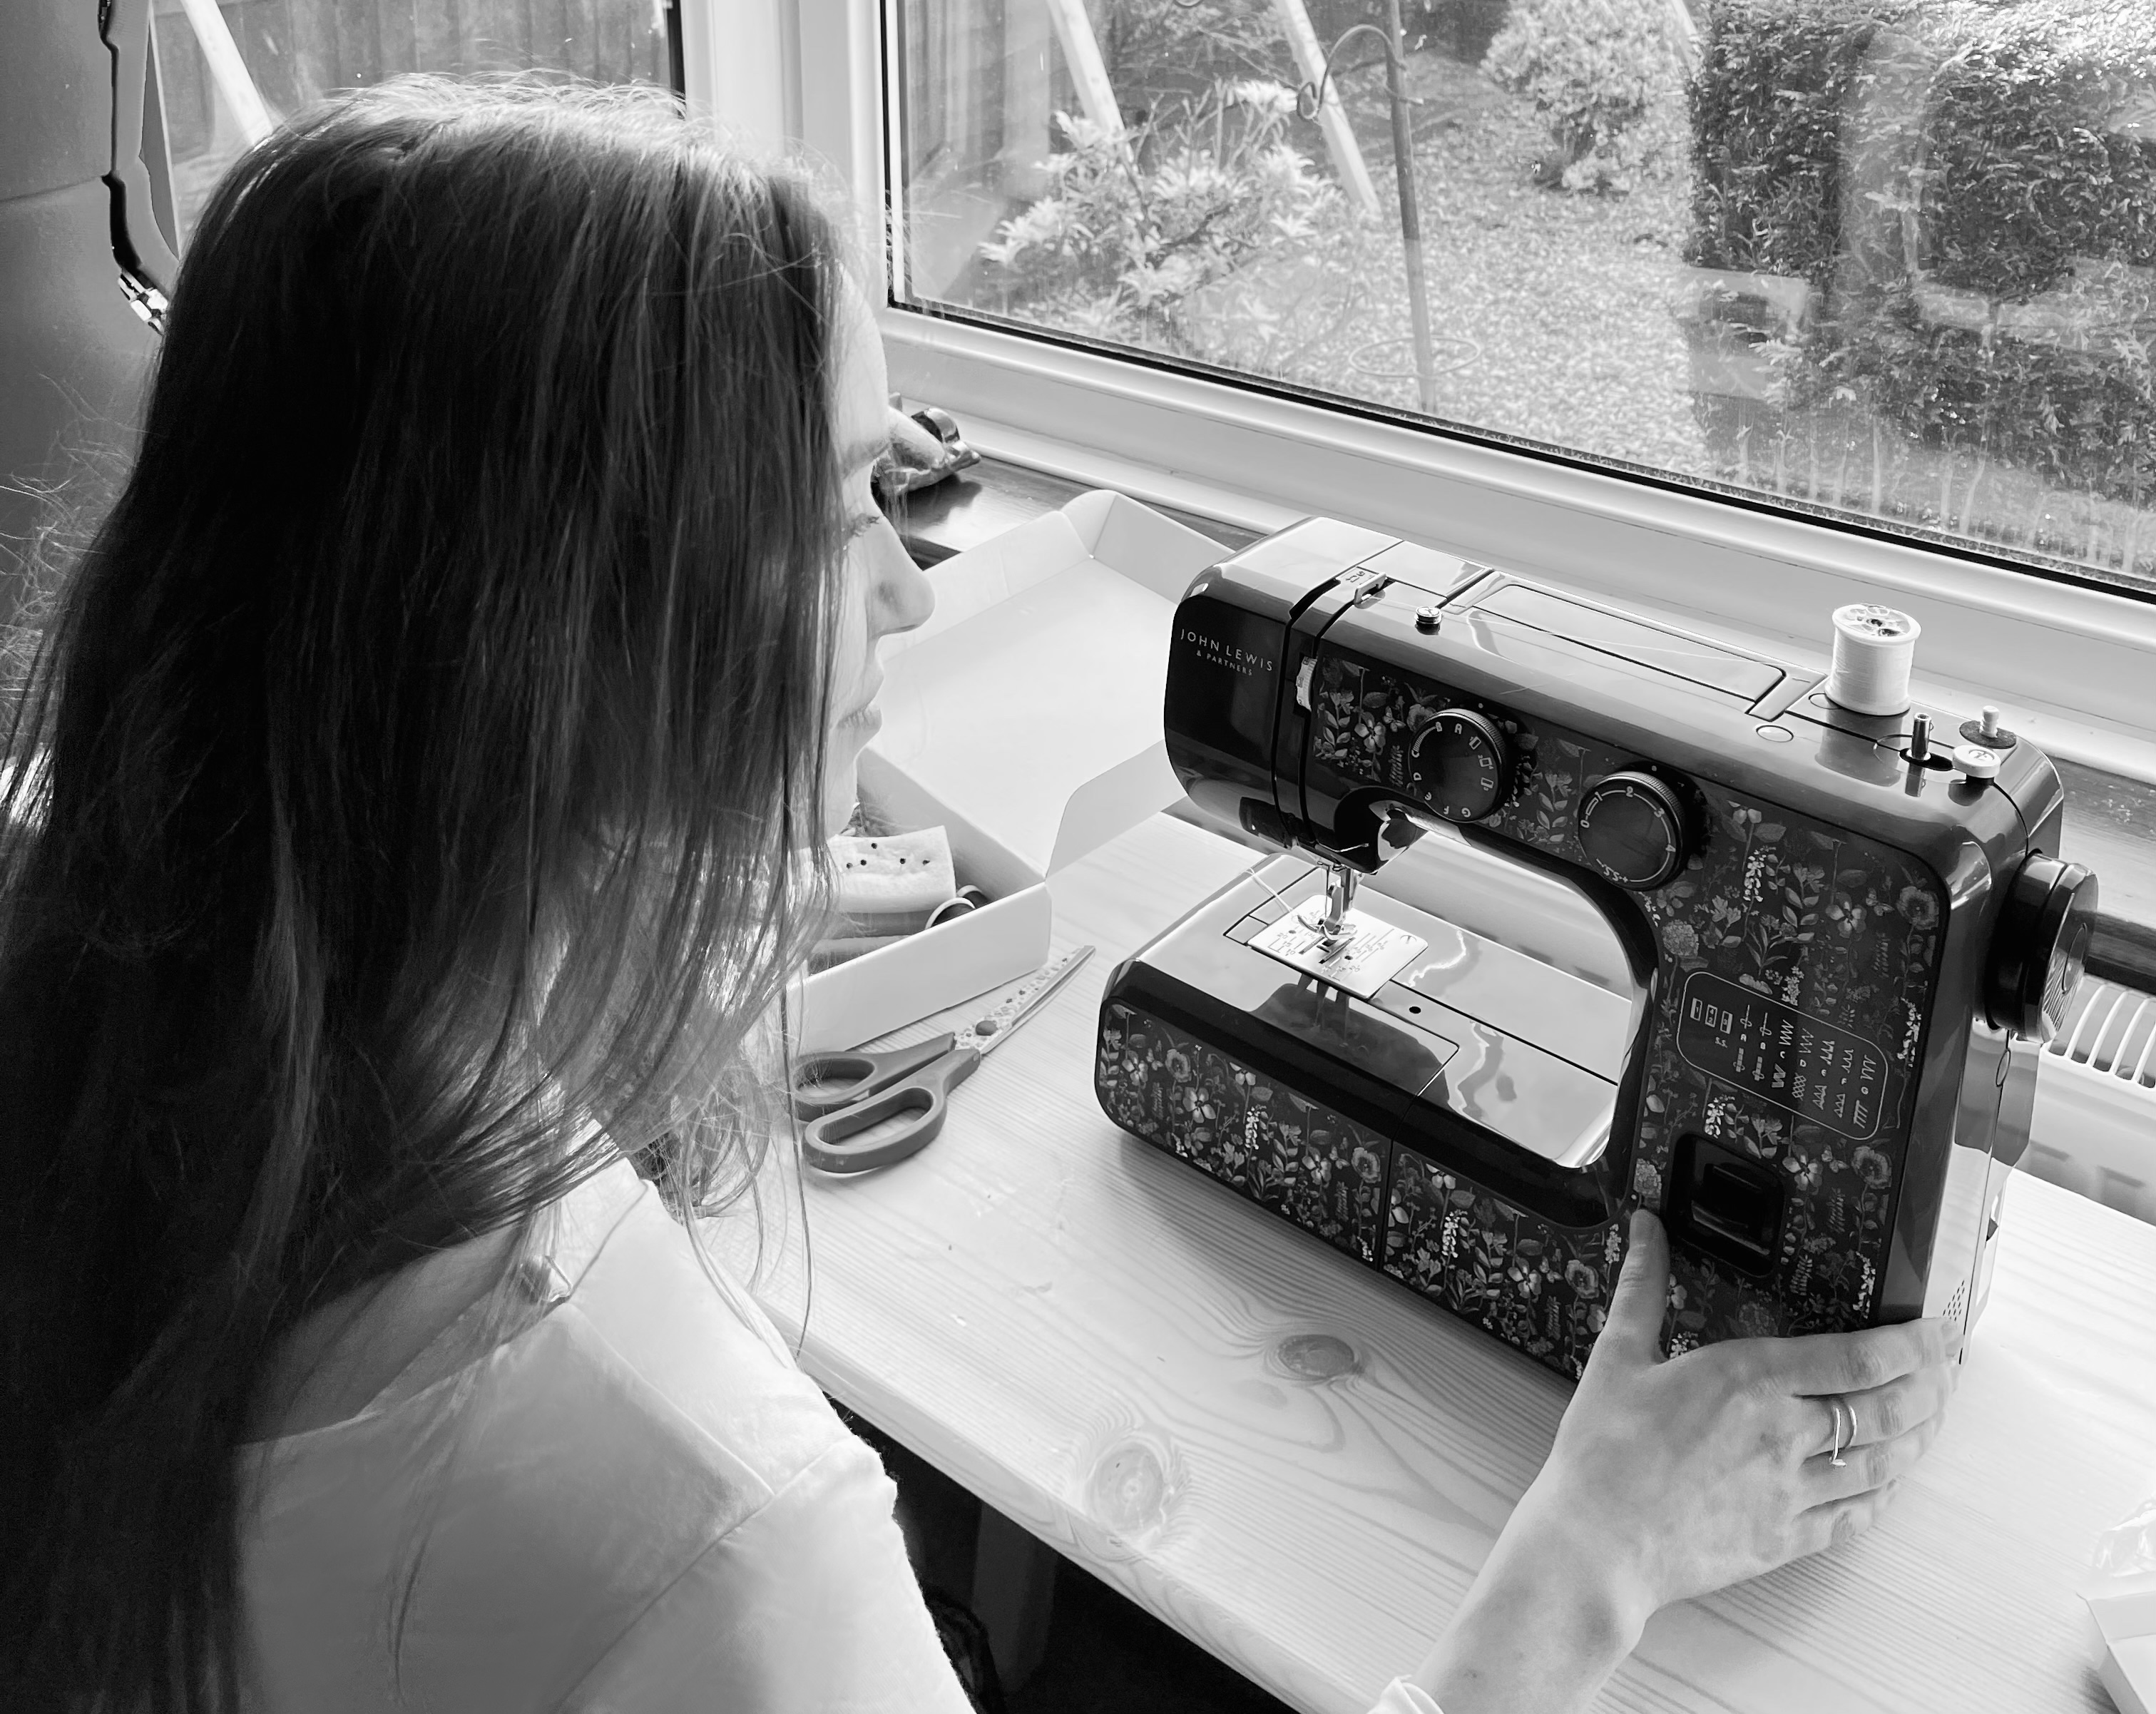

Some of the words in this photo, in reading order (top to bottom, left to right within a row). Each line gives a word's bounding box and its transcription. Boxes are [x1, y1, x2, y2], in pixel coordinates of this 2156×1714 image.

[1180, 628, 1220, 651] JOHN
[1226, 645, 1272, 671] LEWIS
[1206, 653, 1252, 676] PARTNERS
[1454, 723, 1462, 735] A
[1411, 750, 1420, 758] C
[1413, 772, 1422, 781] D
[1594, 791, 1603, 802] 1
[1625, 785, 1634, 798] 2
[1443, 805, 1450, 815] F
[1461, 807, 1471, 818] G
[1653, 807, 1665, 818] 3
[1580, 820, 1590, 829] 0
[1665, 844, 1676, 852] 4
[1740, 1034, 1747, 1042] A
[1861, 1086, 1869, 1095] G
